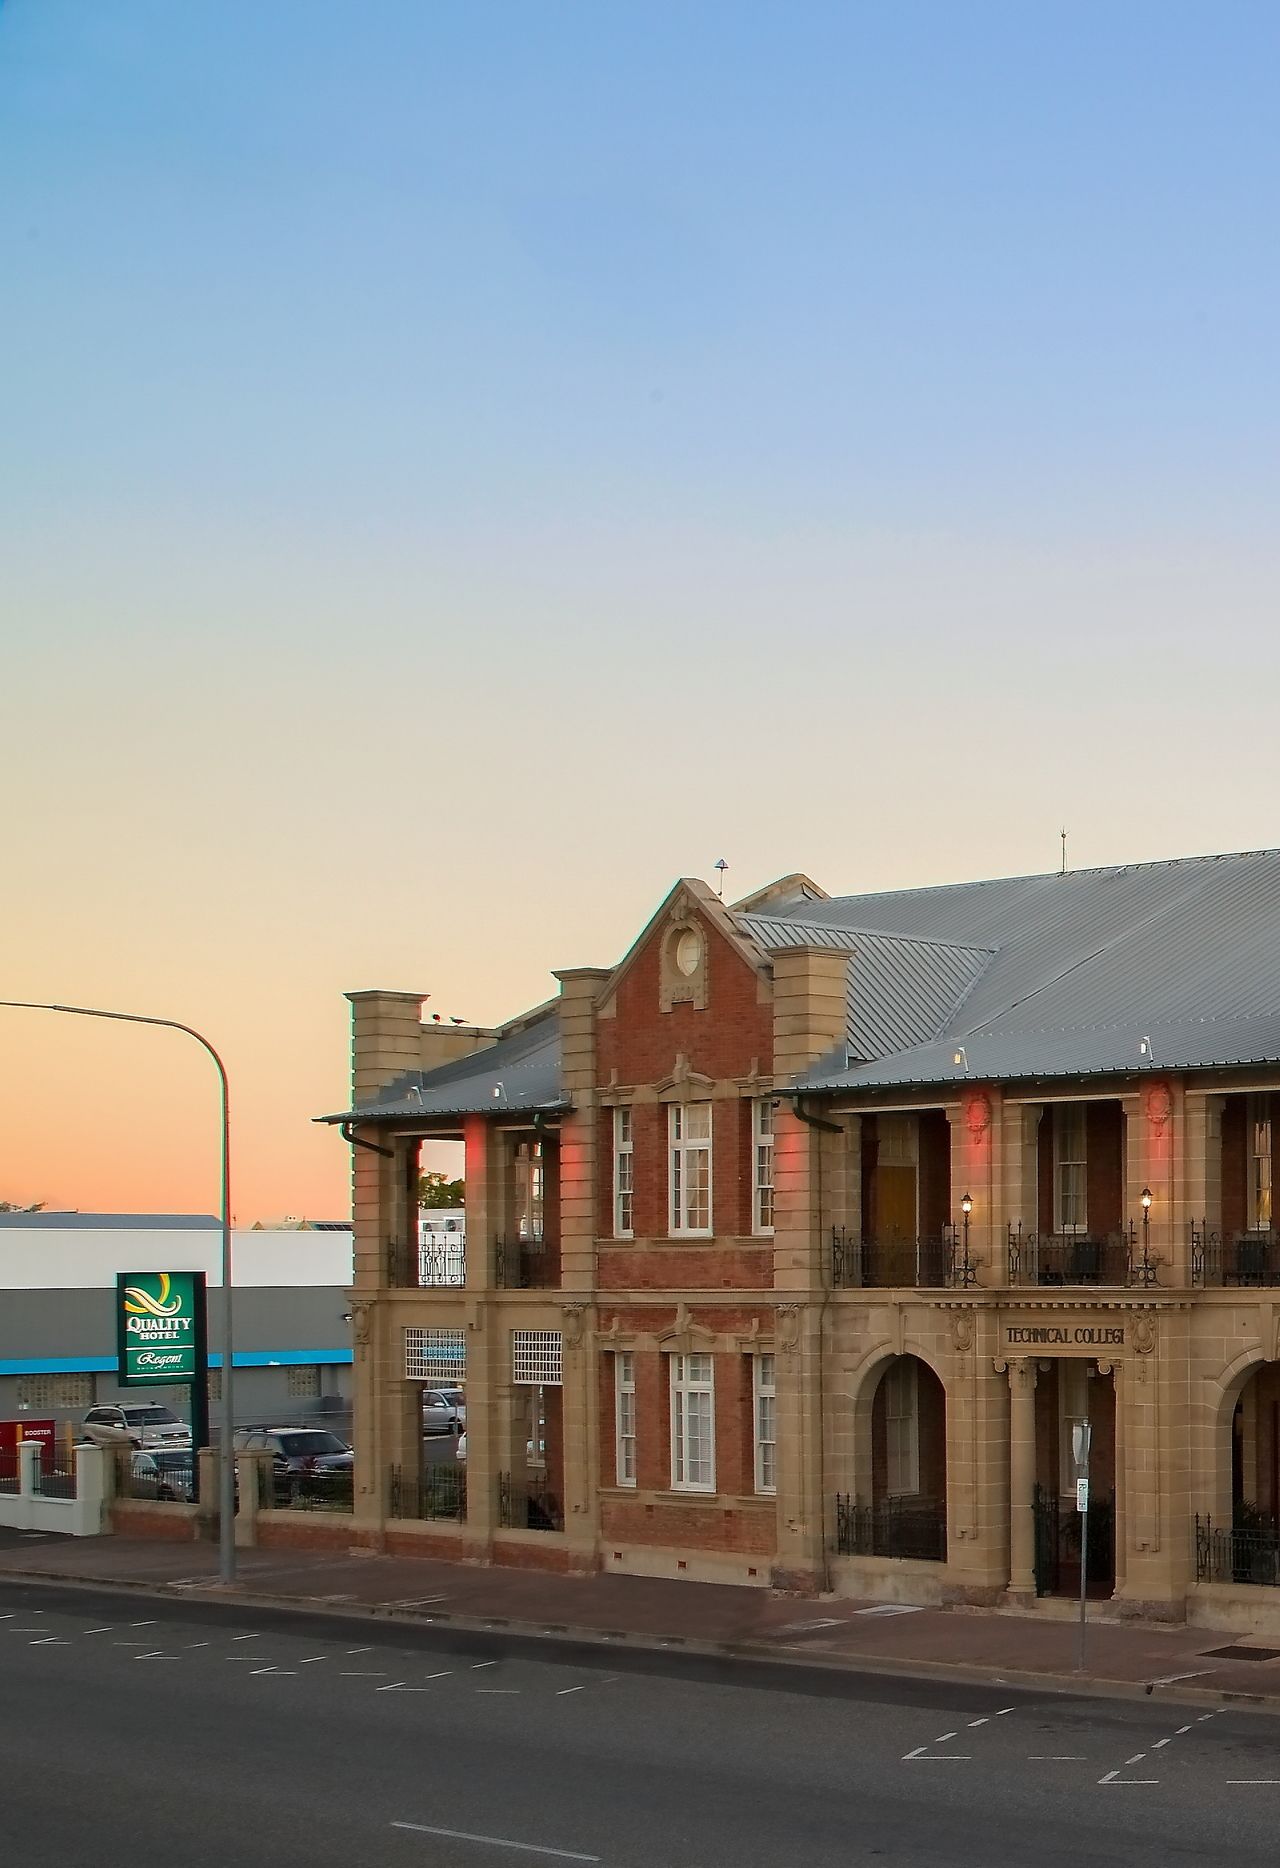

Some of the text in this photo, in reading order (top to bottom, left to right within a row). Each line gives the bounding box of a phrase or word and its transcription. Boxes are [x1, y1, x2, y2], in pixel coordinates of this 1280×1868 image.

[126, 1316, 192, 1334] QUALITY
[139, 1331, 180, 1341] HOTEL
[1006, 1327, 1073, 1343] TECHNICAL
[137, 1352, 183, 1369] Regent
[24, 1429, 52, 1437] BOOSTER
